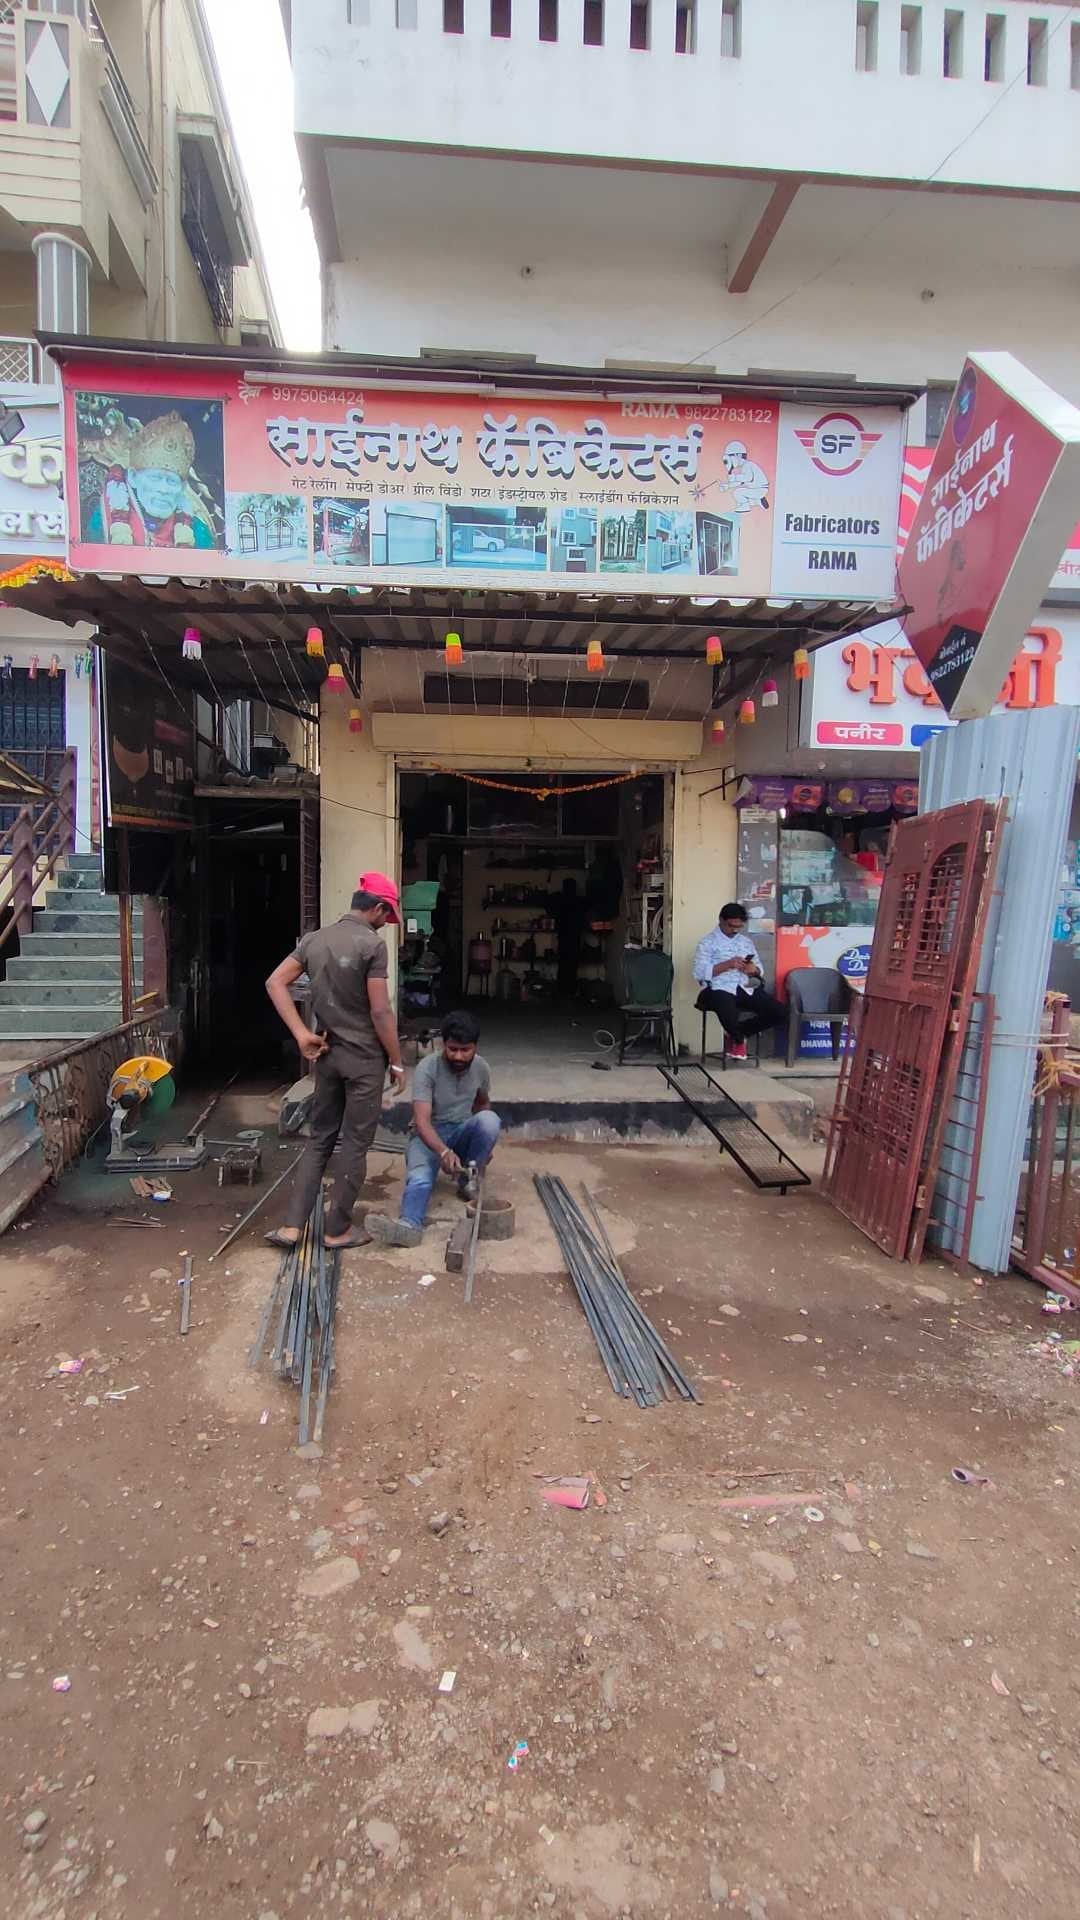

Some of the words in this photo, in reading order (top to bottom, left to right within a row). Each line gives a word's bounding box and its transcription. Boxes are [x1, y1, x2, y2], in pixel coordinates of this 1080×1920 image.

[272, 386, 365, 406] 9975064424
[621, 402, 680, 419] RAMA
[684, 406, 772, 423] 9822783122
[266, 408, 462, 477] साईनाथ
[821, 434, 856, 454] SF
[931, 420, 998, 507] साईनाथ
[291, 476, 307, 489] गेट
[377, 482, 405, 495] डोअर
[470, 487, 491, 498] शटर
[550, 487, 568, 501] शेड
[785, 513, 880, 535] Fabricators
[808, 550, 857, 571] RAMA
[834, 724, 886, 742] पनीर
